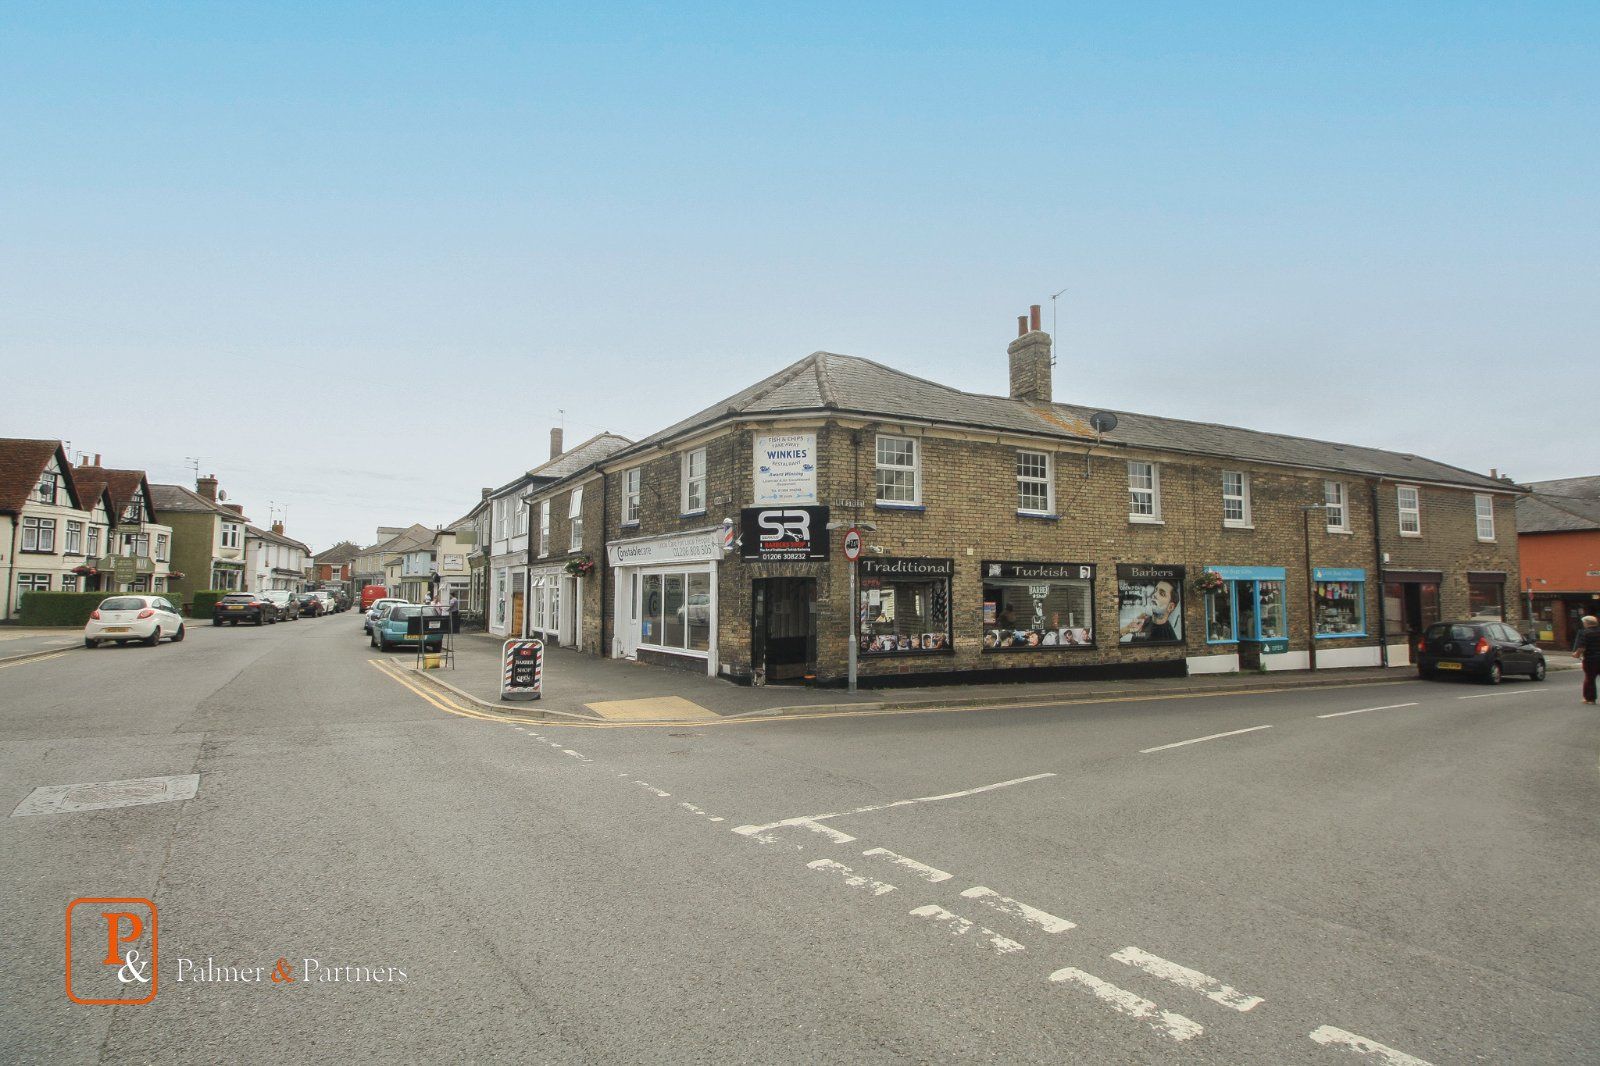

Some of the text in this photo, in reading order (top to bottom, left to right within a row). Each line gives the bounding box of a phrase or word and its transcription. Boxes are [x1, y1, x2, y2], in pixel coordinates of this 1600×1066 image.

[767, 450, 807, 459] WINKIES
[863, 560, 951, 573] Traditional
[1012, 566, 1068, 577] Turkish
[1132, 567, 1174, 577] Barbers
